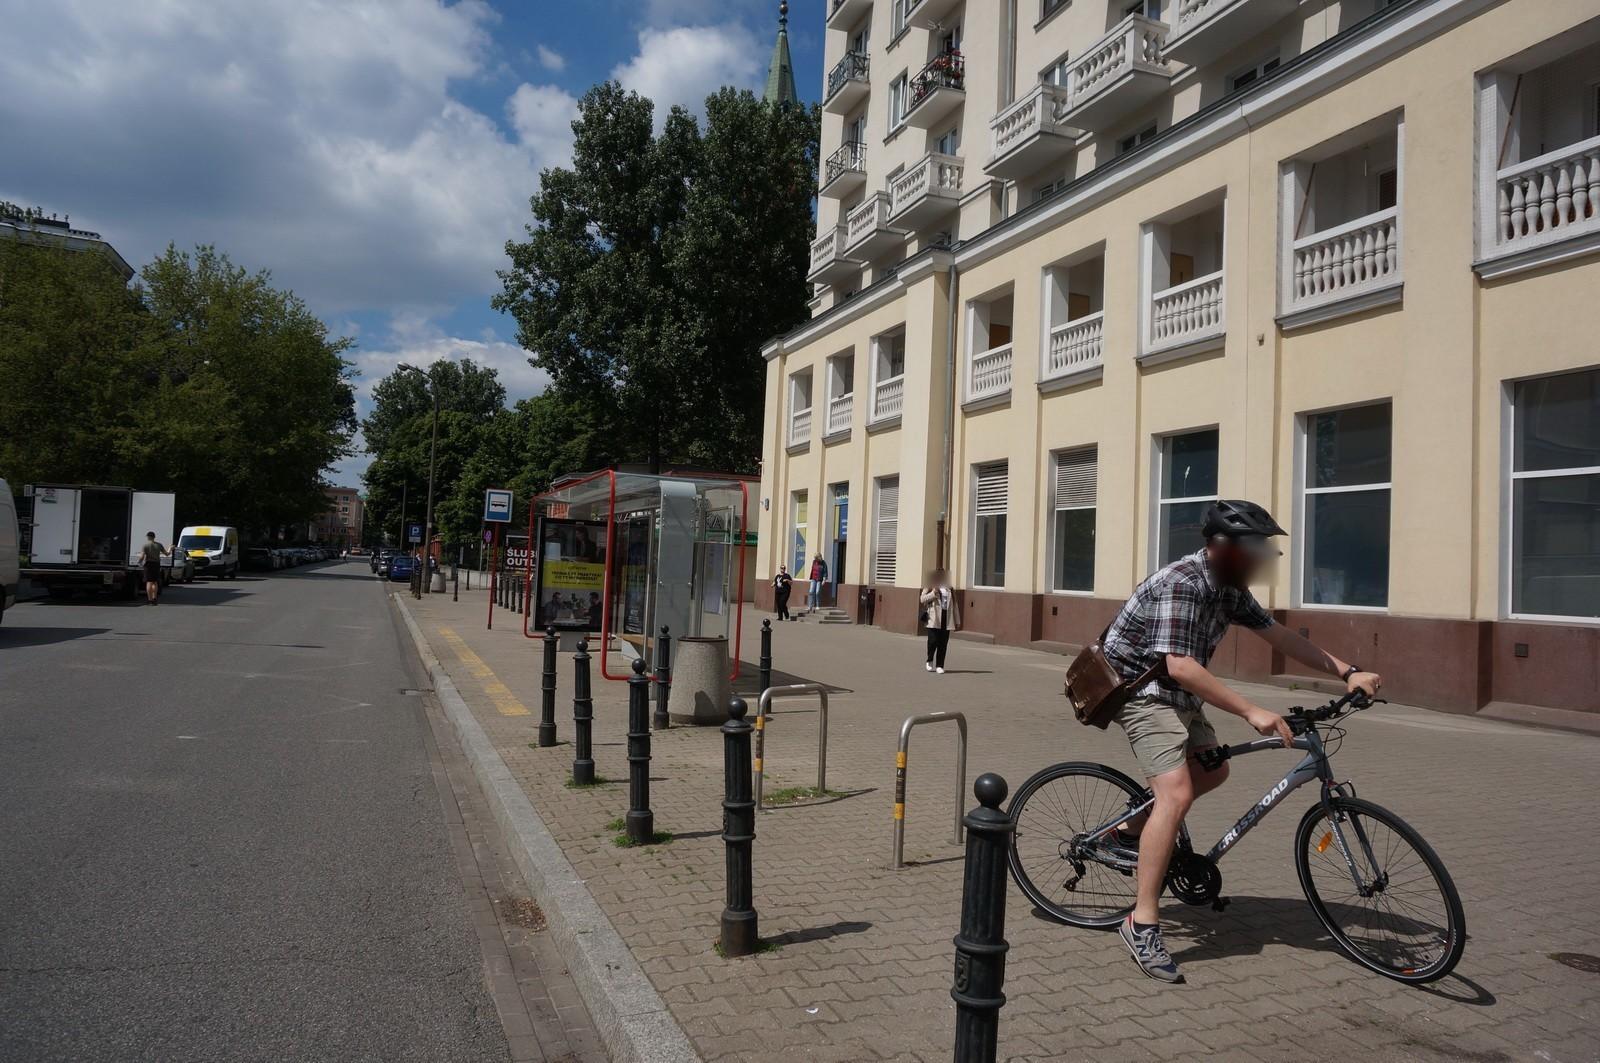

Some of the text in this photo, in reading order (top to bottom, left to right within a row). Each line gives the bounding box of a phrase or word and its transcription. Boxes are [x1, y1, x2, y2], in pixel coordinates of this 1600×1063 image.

[411, 526, 420, 536] P
[506, 546, 538, 558] ŚLUB
[1218, 778, 1289, 850] CROSSROAD
